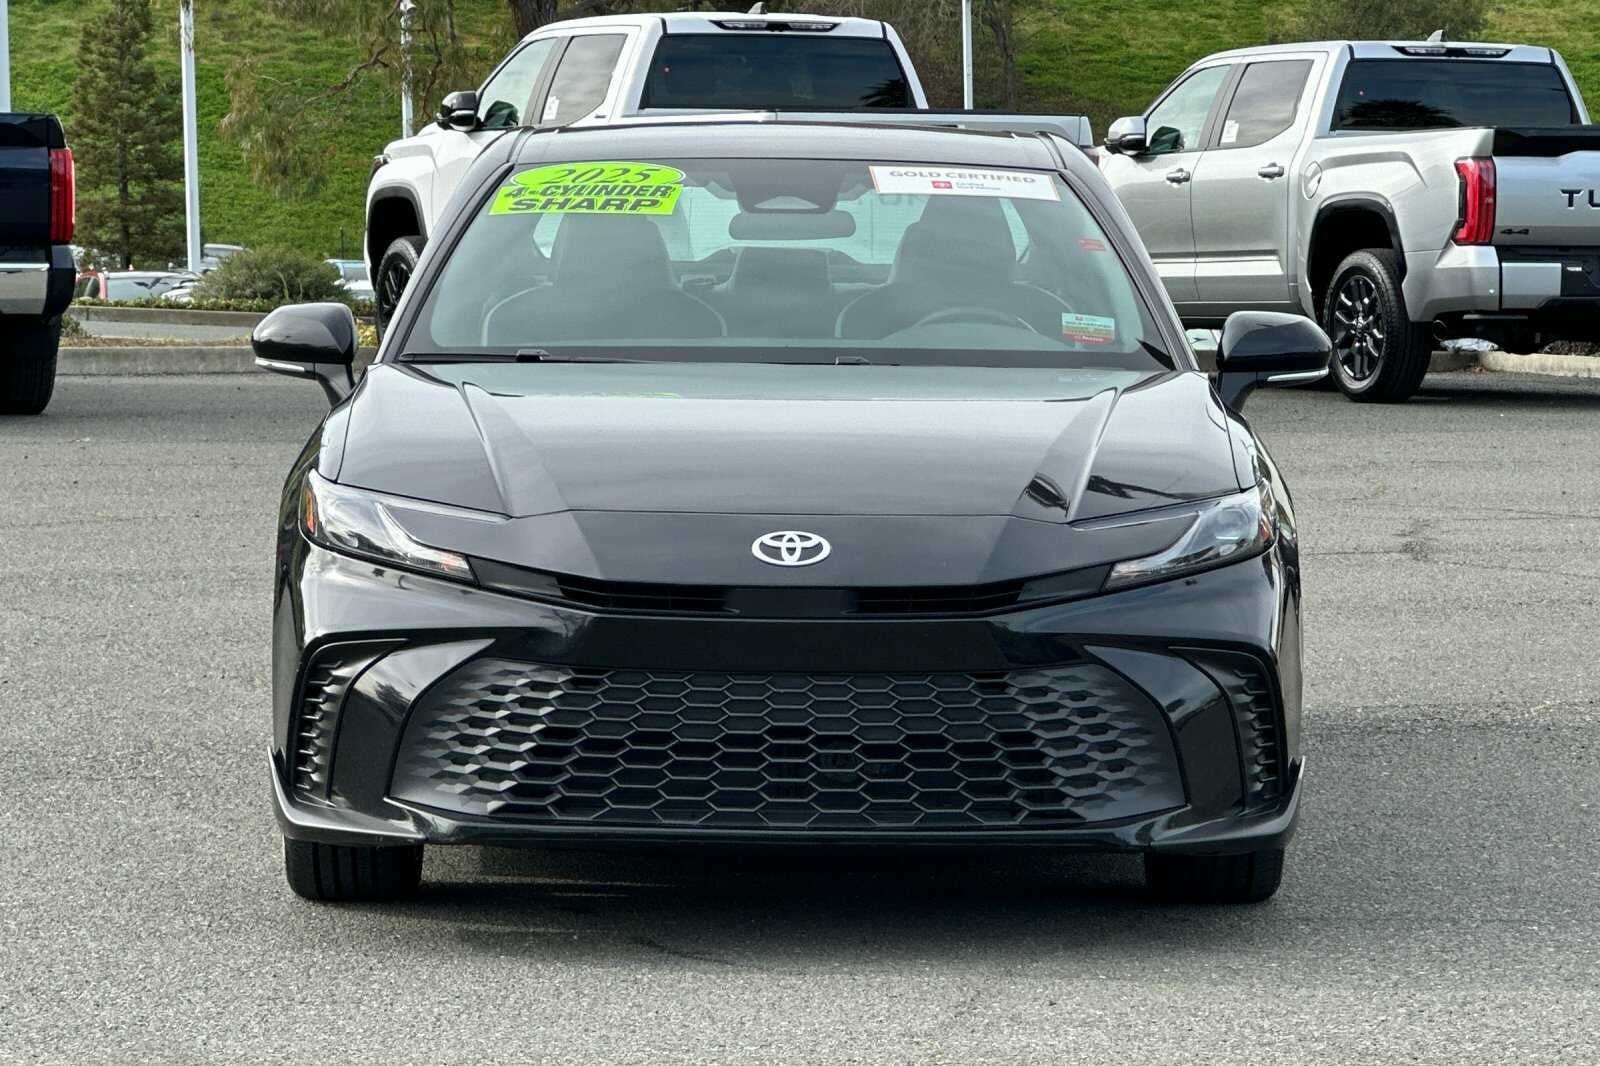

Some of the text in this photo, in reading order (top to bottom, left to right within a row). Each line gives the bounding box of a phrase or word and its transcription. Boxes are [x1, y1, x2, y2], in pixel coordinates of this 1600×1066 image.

[541, 167, 661, 184] 2025
[889, 169, 1036, 183] GOLD CERTIFIED
[504, 184, 676, 198] 4-CYLINDER
[508, 198, 663, 212] SHARP
